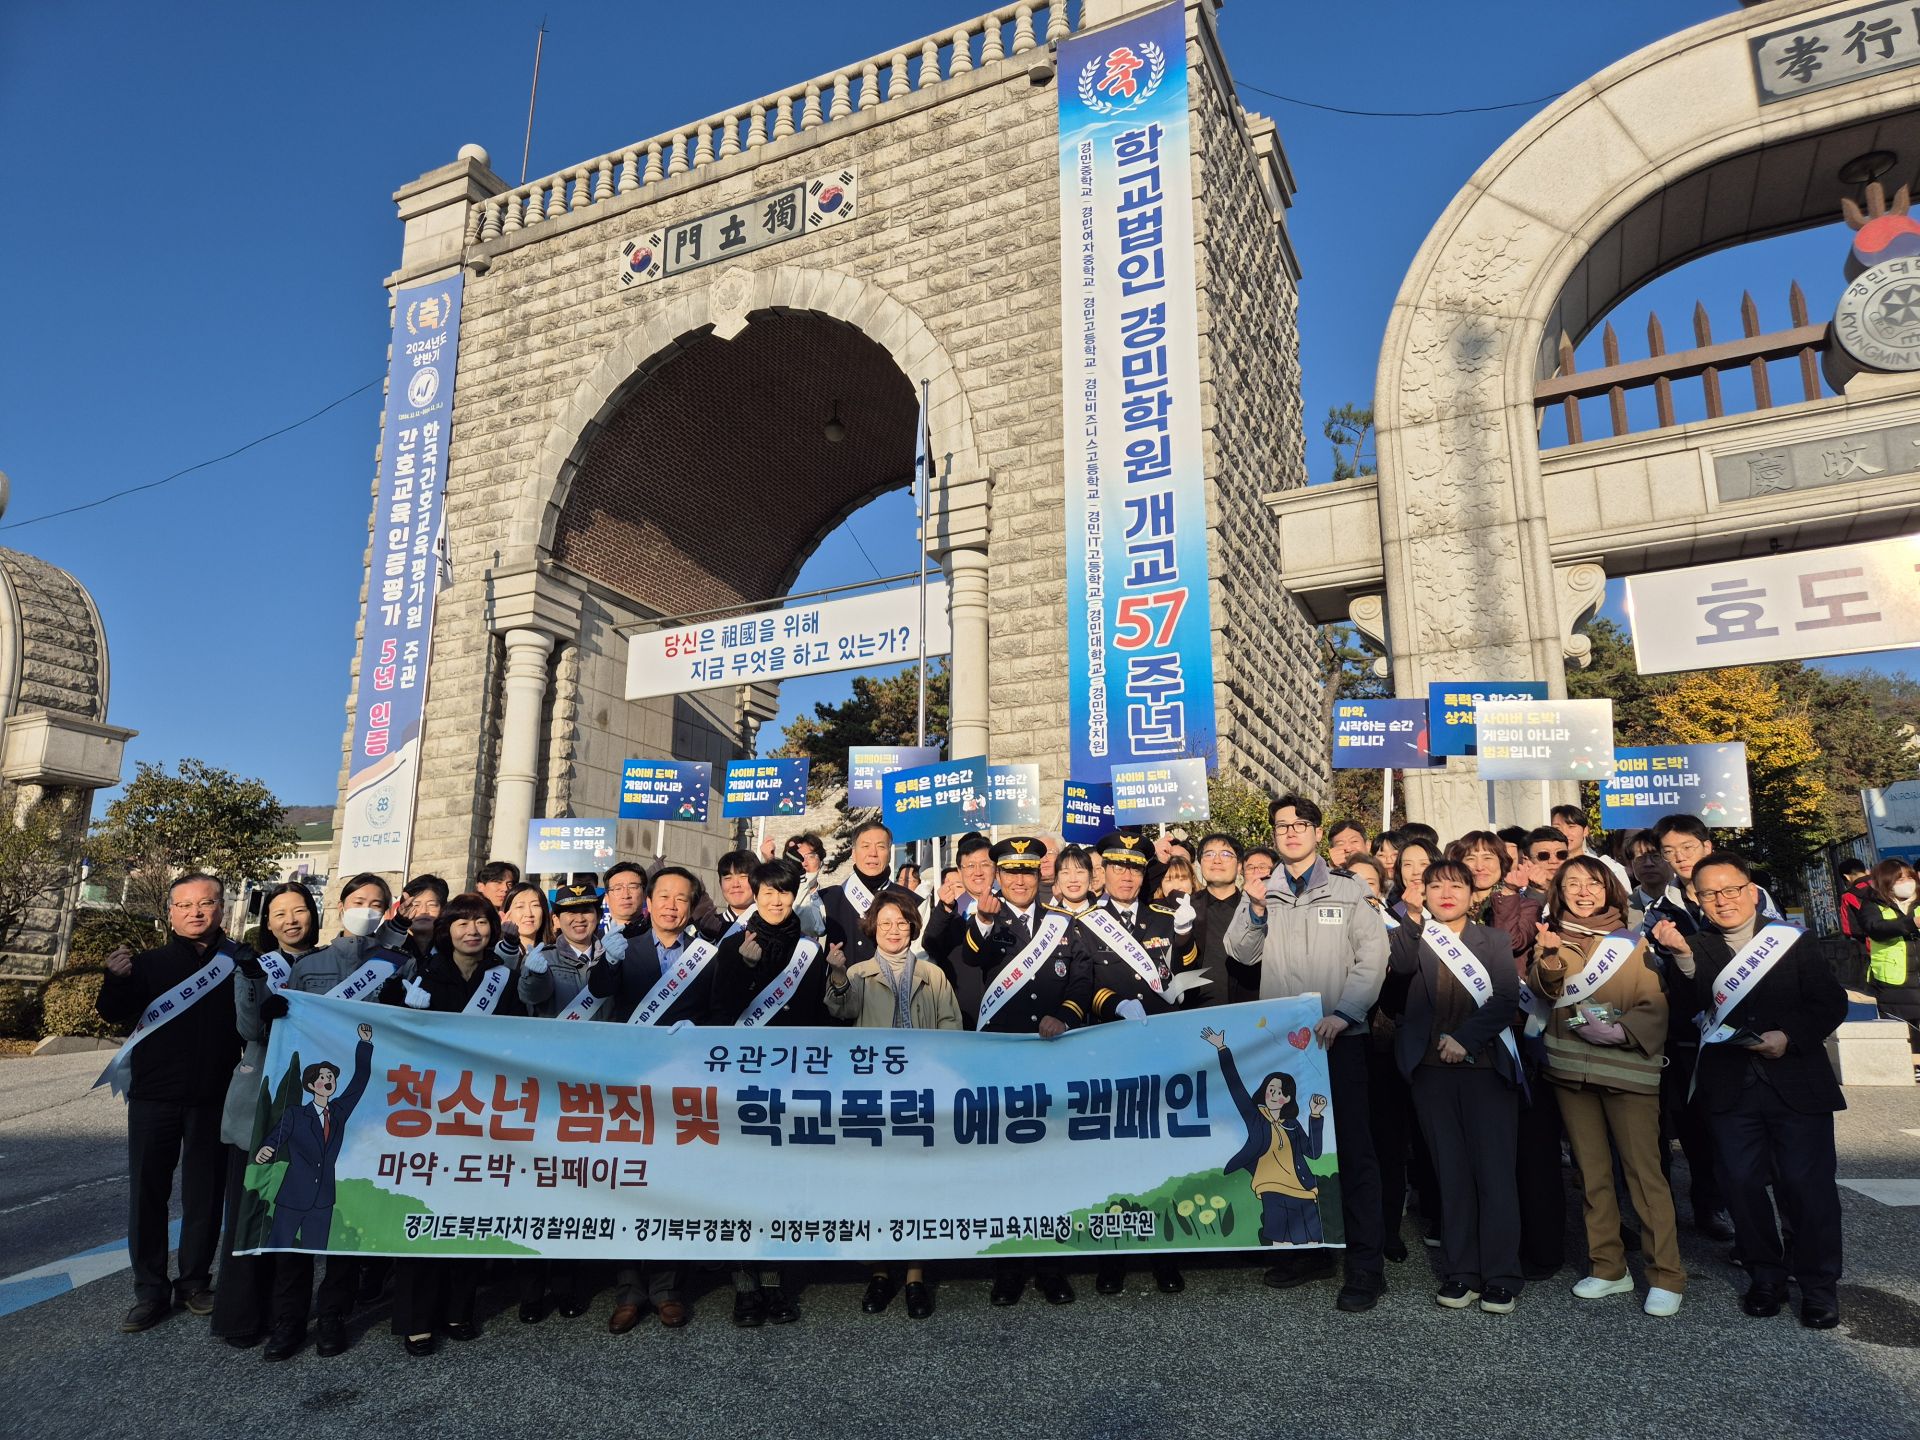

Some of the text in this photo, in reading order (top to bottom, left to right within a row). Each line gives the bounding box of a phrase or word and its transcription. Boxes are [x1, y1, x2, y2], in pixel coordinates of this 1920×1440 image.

[1775, 8, 1920, 83] 孝行
[1114, 123, 1166, 297] 학교법인
[406, 332, 447, 355] 2024년도
[1841, 312, 1910, 364] KYUNGMIN
[412, 349, 440, 367] 상반기
[1120, 301, 1173, 484] 경민학원
[1080, 141, 1106, 753] 경민중학교 경민여자중학교 경민고등학교 경민비즈니스고등학교 경민IT고등학교 경민대학교 경민유치원
[380, 428, 419, 626] 간호교육인증평가
[1125, 490, 1177, 587] 개교
[1696, 566, 1882, 645] 효도
[664, 610, 820, 658] 당신은 祖國을 위해
[373, 639, 397, 690] 5년
[400, 640, 419, 689] 주관
[690, 626, 910, 682] 지금 무엇을 하고 있는가?
[365, 701, 391, 756] 인증
[1338, 720, 1414, 731] 시작하는 순간
[1445, 711, 1476, 725] 상처
[1483, 712, 1560, 724] 사이버 도박!
[1338, 735, 1385, 746] 끝입니다
[1482, 729, 1570, 741] 게임이 아니라
[1482, 746, 1551, 758] 범죄입니다
[1652, 756, 1689, 770] 도박!
[625, 767, 678, 779] 사이버 도박!
[728, 778, 783, 790] 게임이 아니라
[730, 766, 778, 778] 사이버 도박!
[895, 776, 931, 793] 폭력은
[934, 769, 973, 787] 한순간
[994, 774, 1027, 786] 한순간
[1653, 773, 1701, 787] 아니라
[624, 780, 683, 792] 게임이 아니라
[1116, 782, 1179, 797] 게임이 아니라
[623, 793, 669, 804] 범죄입니다
[895, 795, 932, 813] 상처는
[935, 786, 974, 805] 한평생
[1605, 791, 1680, 807] 범죄입니다
[351, 831, 400, 848] 경민대학교
[573, 827, 606, 837] 한순간
[573, 840, 605, 850] 한평생
[1427, 926, 1487, 992] 도박의 끝은
[1585, 948, 1618, 986] 도박의
[1724, 936, 1779, 992] 학교폭력은
[179, 966, 221, 1000] 도박의
[476, 972, 502, 1011] 도박의
[634, 1000, 660, 1024] 없습
[704, 1045, 908, 1074] 유관기관 합동
[385, 1063, 1211, 1147] 청소년 범죄 및 학교폭력 예방 캠페인
[405, 1211, 1155, 1243] 경기도북부자치경찰위원회 경기북부경찰청 의정부경찰서 경기도의정부교육지원청 경민학원
